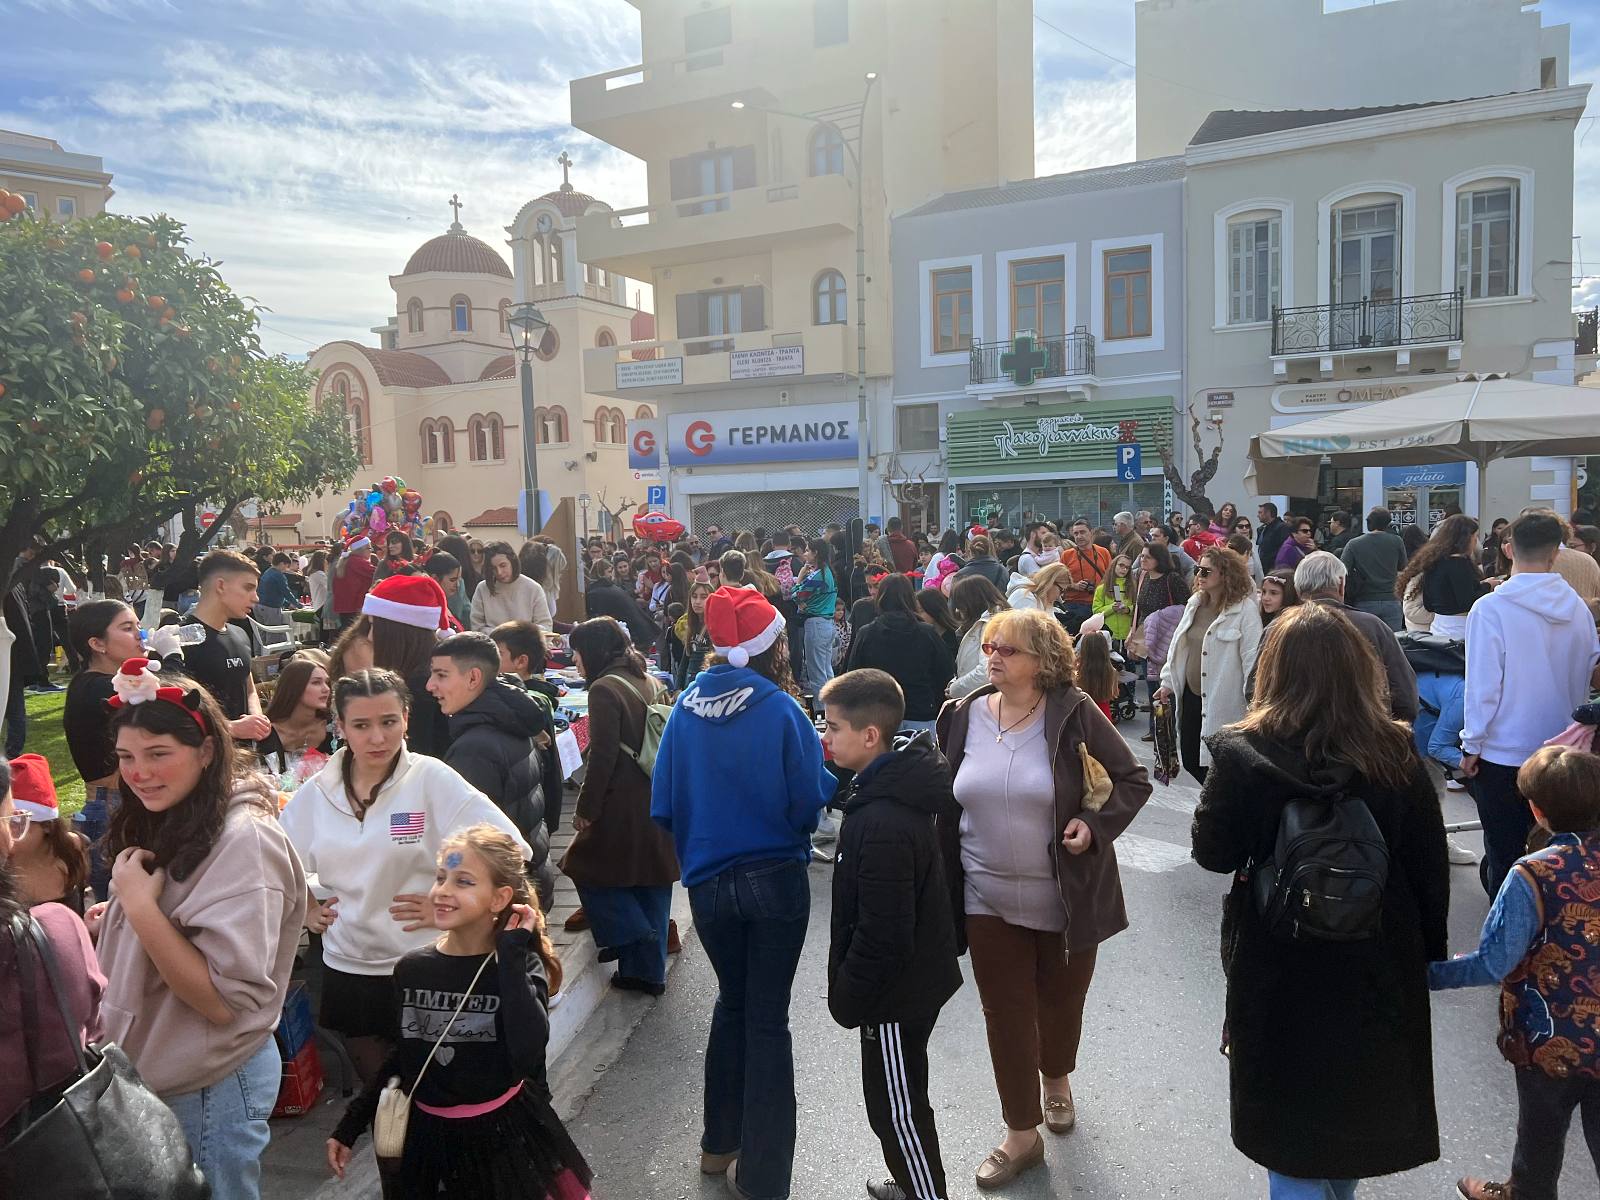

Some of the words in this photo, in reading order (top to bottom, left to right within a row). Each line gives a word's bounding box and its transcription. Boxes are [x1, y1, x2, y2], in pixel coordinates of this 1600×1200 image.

[728, 420, 849, 447] ΓΕΡΜΑΝΟΣ
[1122, 447, 1135, 464] P
[1400, 471, 1445, 486] gelato
[652, 487, 662, 504] P
[402, 987, 500, 1013] LIMITED
